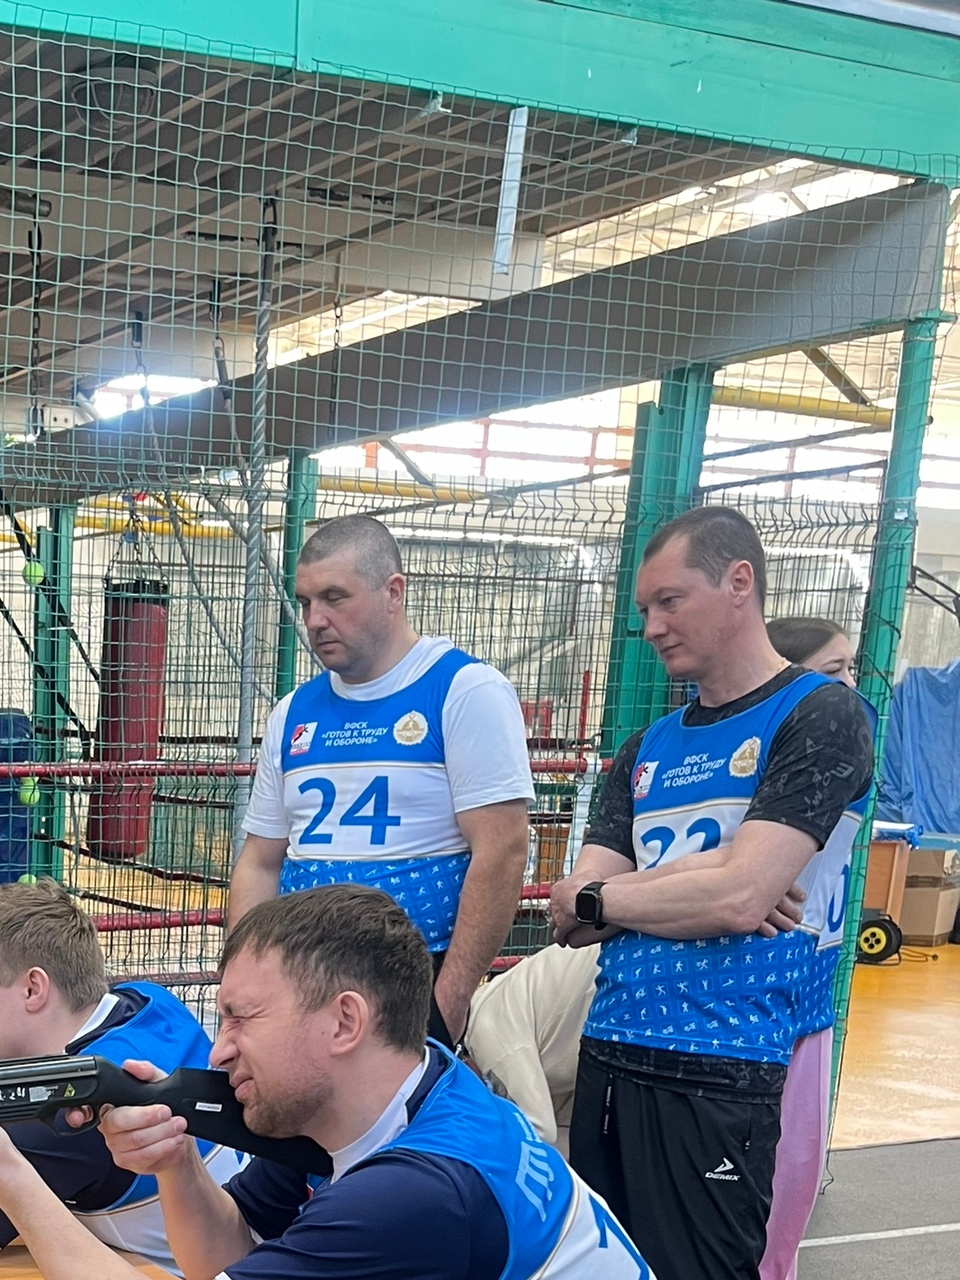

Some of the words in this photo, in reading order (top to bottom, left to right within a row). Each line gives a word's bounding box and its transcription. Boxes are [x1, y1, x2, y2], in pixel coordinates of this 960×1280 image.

[344, 721, 368, 730] ВФСК
[321, 730, 351, 739] «ГОТОВ
[352, 729, 359, 737] К
[361, 727, 388, 738] ТРУДУ
[325, 739, 332, 747] И
[333, 737, 378, 746] ОБОРОНЕ»
[683, 753, 709, 766] ВФСК
[661, 766, 691, 780] «ГОТОВ
[692, 765, 700, 774] К
[700, 758, 727, 772] ТРУДУ
[663, 779, 672, 788] И
[672, 772, 714, 787] ОБОРОНЕ»
[298, 775, 402, 846] 24
[704, 1171, 741, 1182] DEMIX
